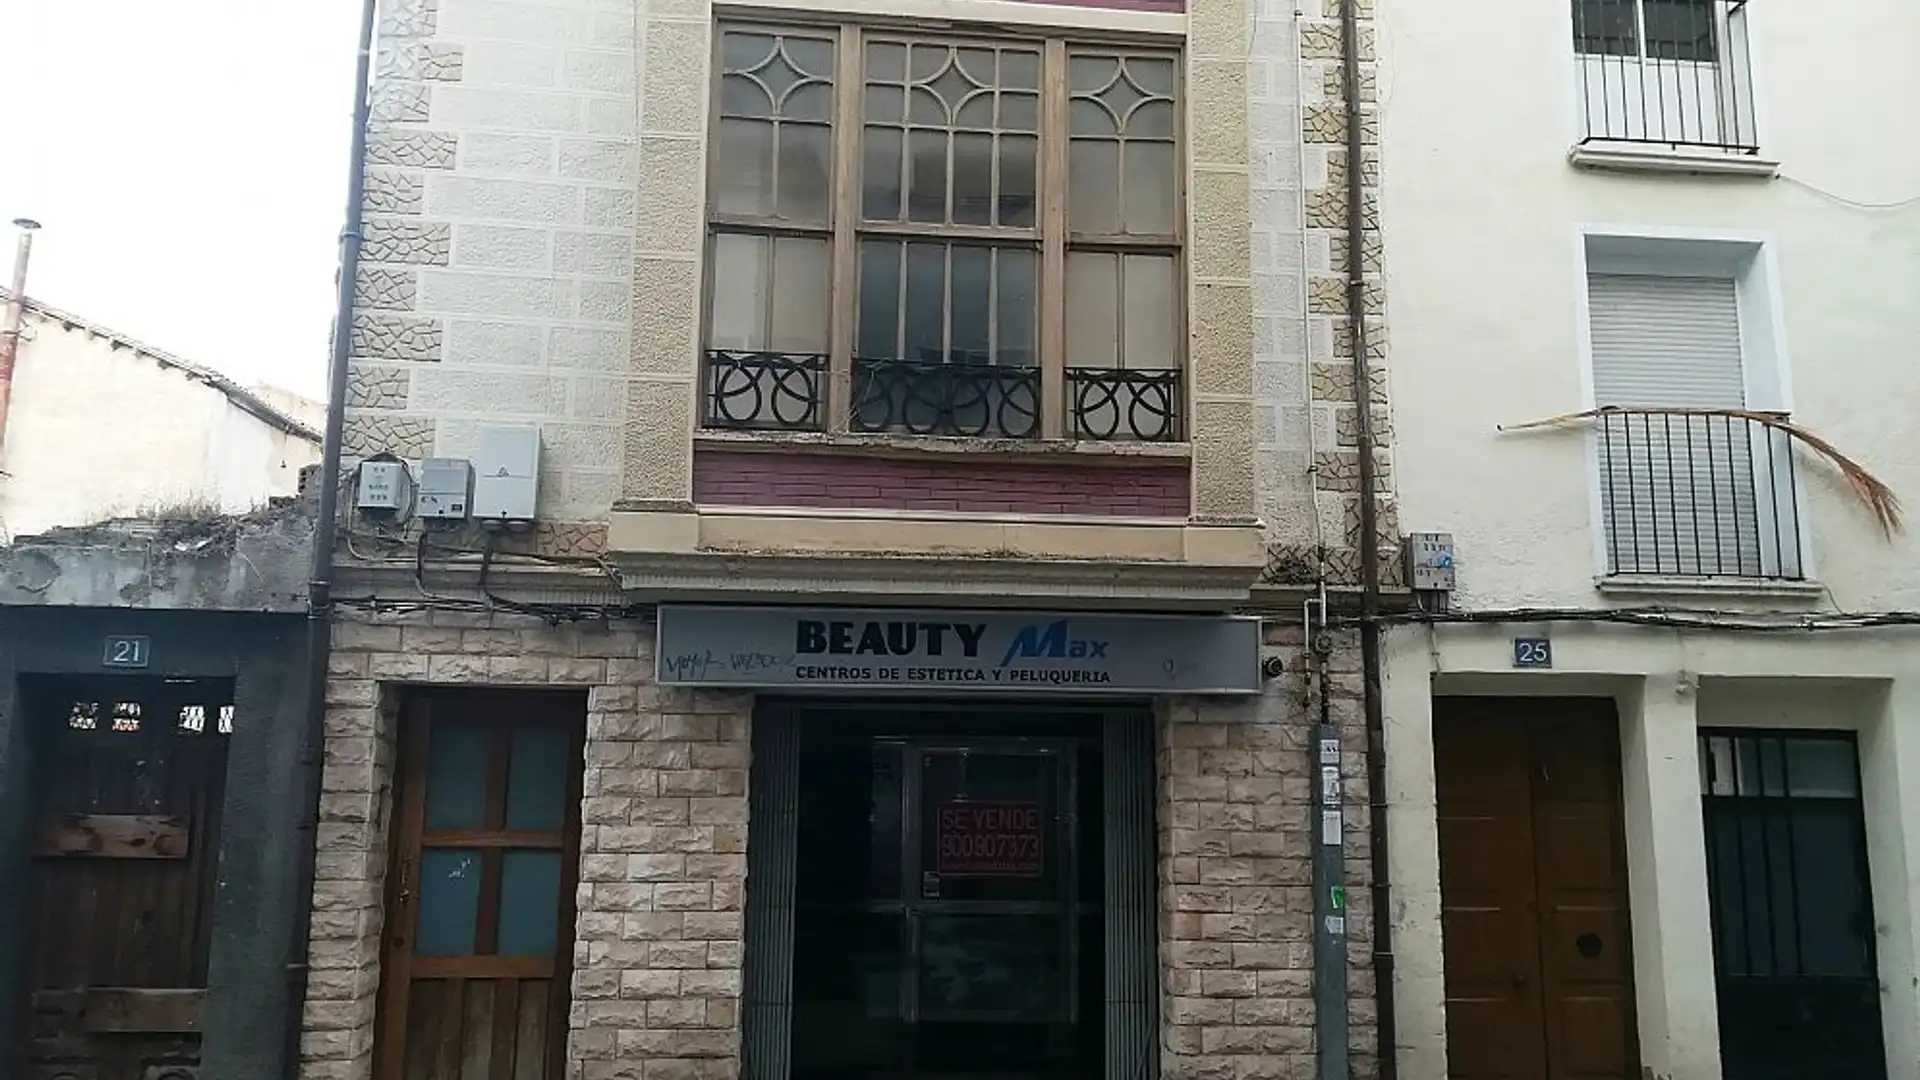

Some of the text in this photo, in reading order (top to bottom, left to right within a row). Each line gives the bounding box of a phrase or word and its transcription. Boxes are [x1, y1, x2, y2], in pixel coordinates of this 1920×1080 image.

[113, 640, 139, 662] 21
[796, 619, 1109, 667] BEAUTY Max
[1518, 642, 1547, 661] 25
[796, 666, 1111, 684] CENTROS DE ESTETICA Y PELUQUERIA
[942, 809, 1039, 830] SE VENDE
[942, 834, 1039, 858] 900907373
